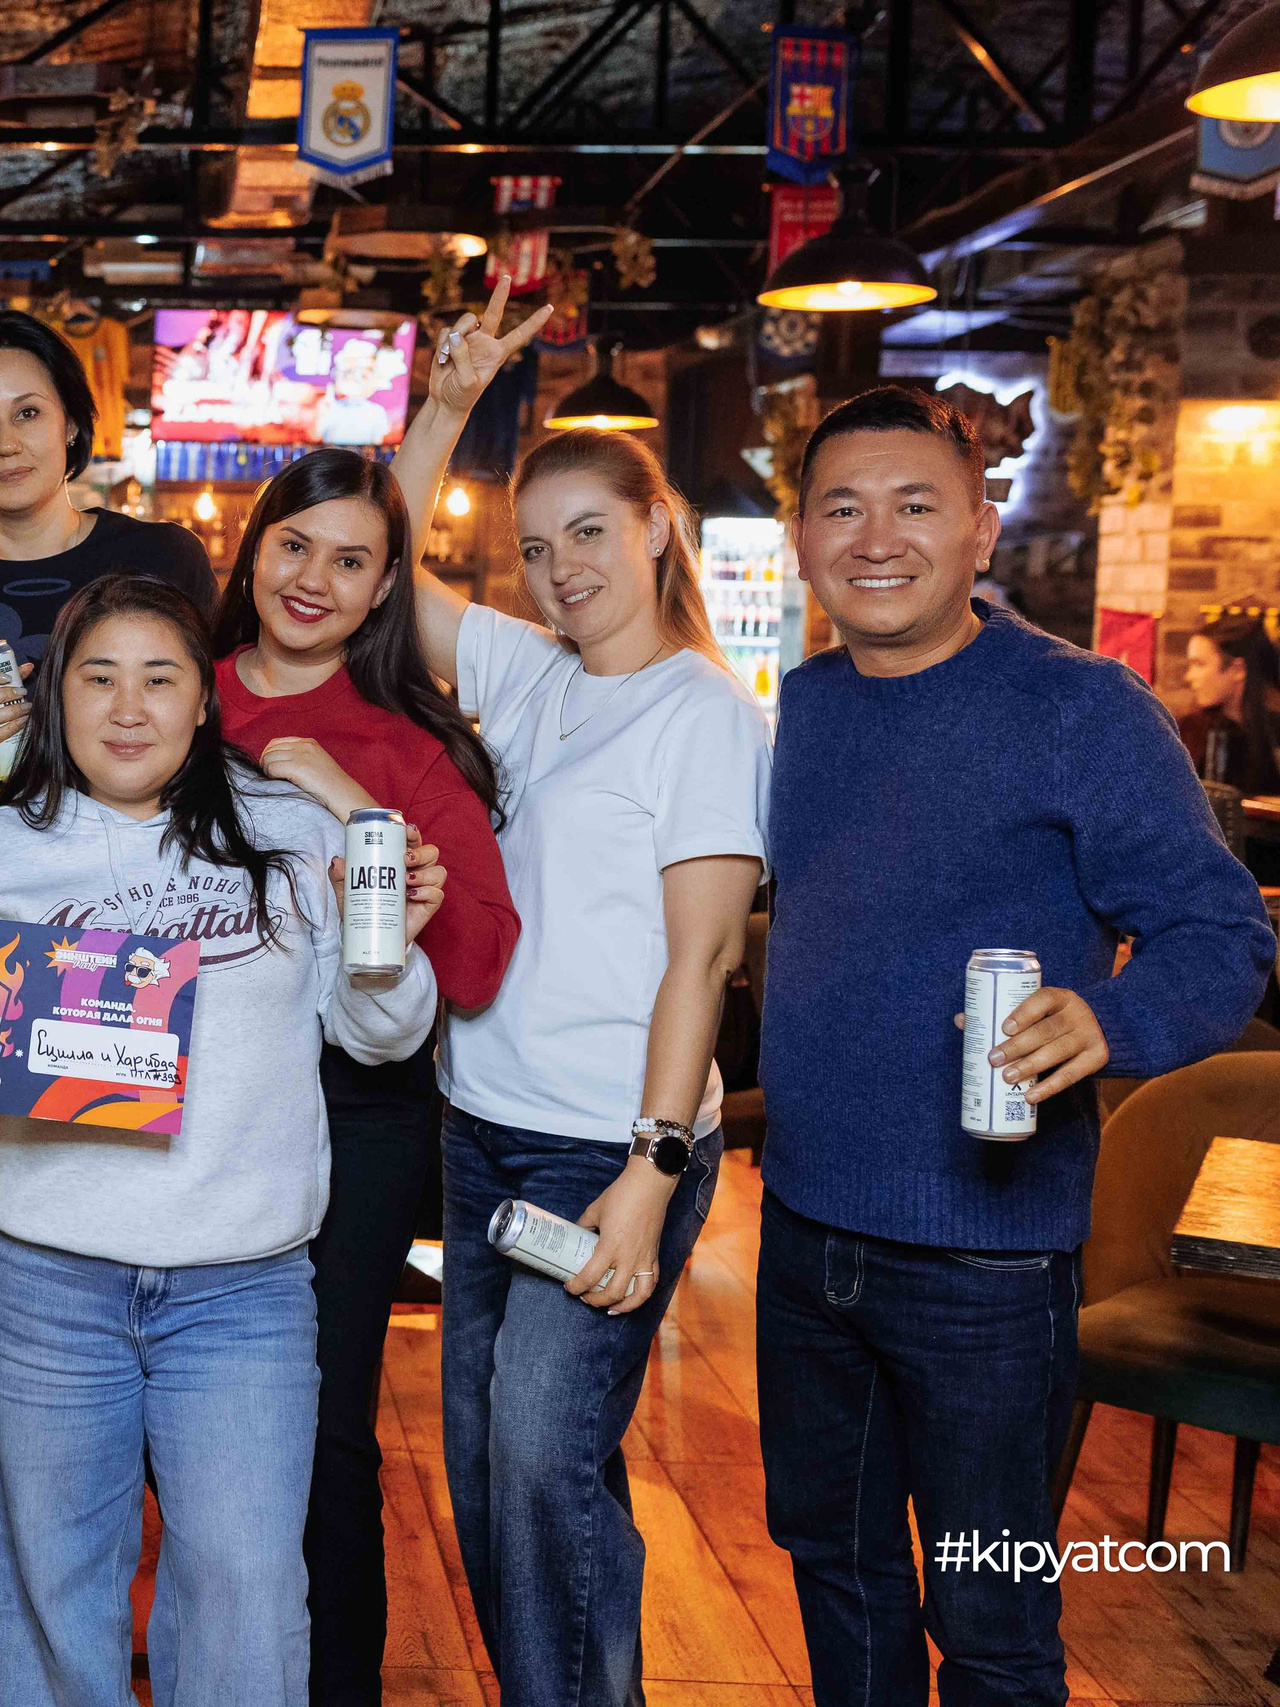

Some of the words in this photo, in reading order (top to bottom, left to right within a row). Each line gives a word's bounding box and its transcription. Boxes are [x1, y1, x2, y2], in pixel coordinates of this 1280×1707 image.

[188, 875, 242, 895] NOHO
[351, 866, 396, 890] LAGER
[146, 896, 174, 910] SCE
[176, 893, 200, 906] 1986
[80, 997, 137, 1013] КОМАНДА,
[52, 1006, 101, 1020] КОТОРАЯ
[101, 1011, 134, 1024] ДАЛА
[136, 1016, 163, 1027] ОГНЯ
[101, 1053, 112, 1062] и
[113, 1043, 180, 1072] Харибда
